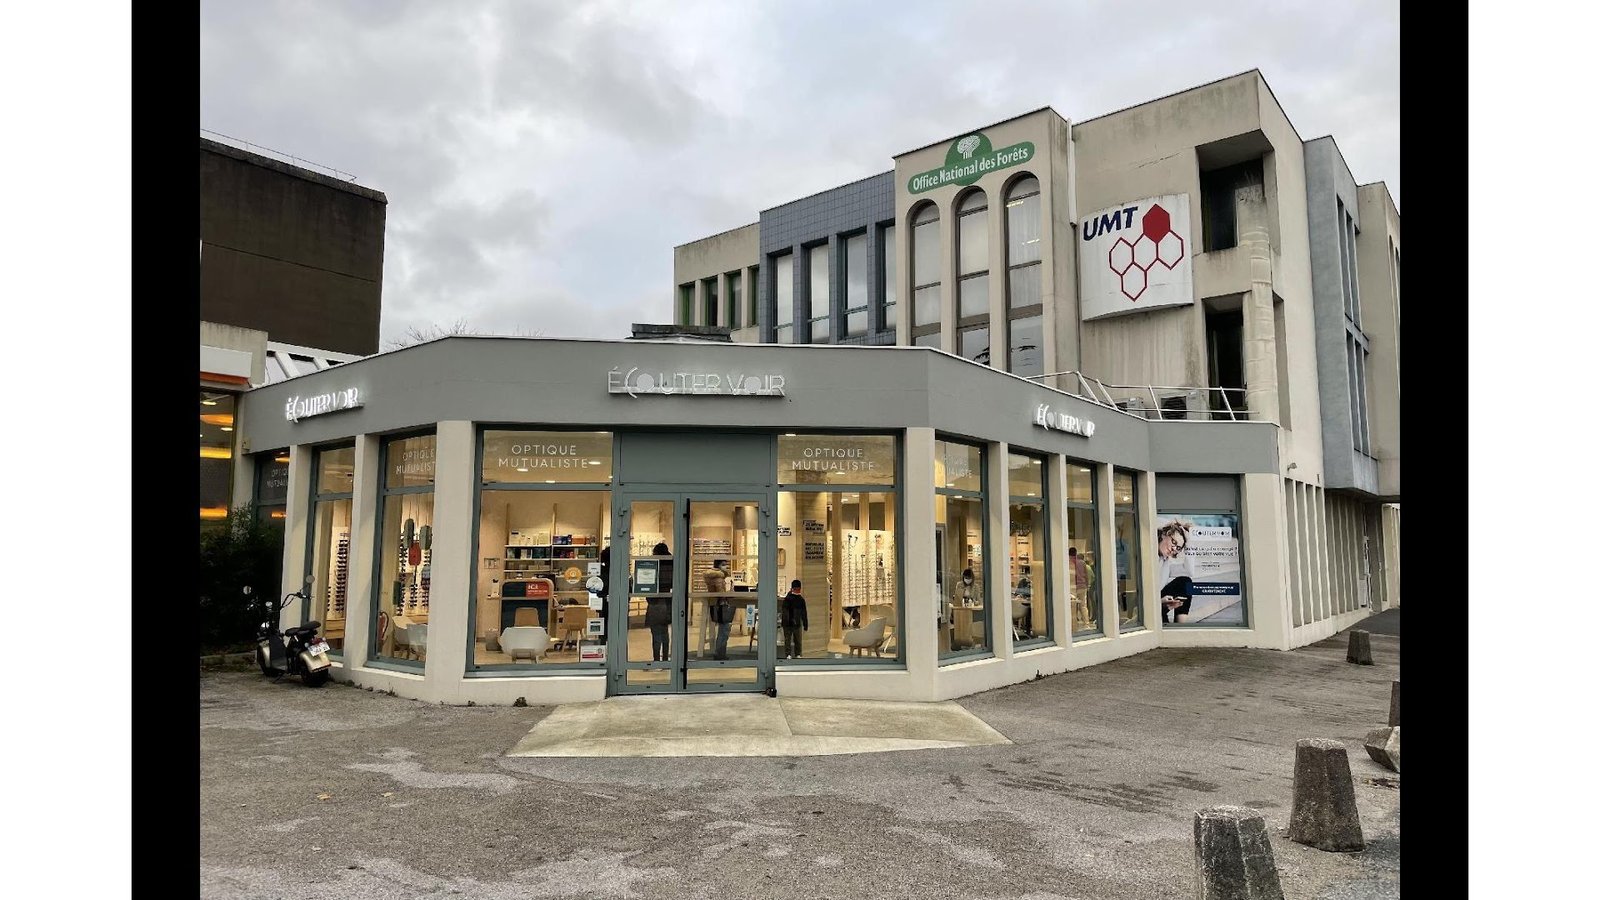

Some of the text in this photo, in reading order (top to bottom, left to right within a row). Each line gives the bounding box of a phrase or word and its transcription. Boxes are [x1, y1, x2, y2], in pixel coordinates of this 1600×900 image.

[912, 147, 1029, 191] Office National des Forêts
[1083, 206, 1139, 241] UMT
[608, 366, 786, 398] ÉCOUTER VOIR
[511, 444, 577, 456] OPTIQUE
[803, 448, 865, 458] OPTIQUE
[395, 461, 436, 475] MUTUALIST
[498, 458, 589, 469] MUTUALISTE
[792, 460, 876, 471] MUTUALISTE
